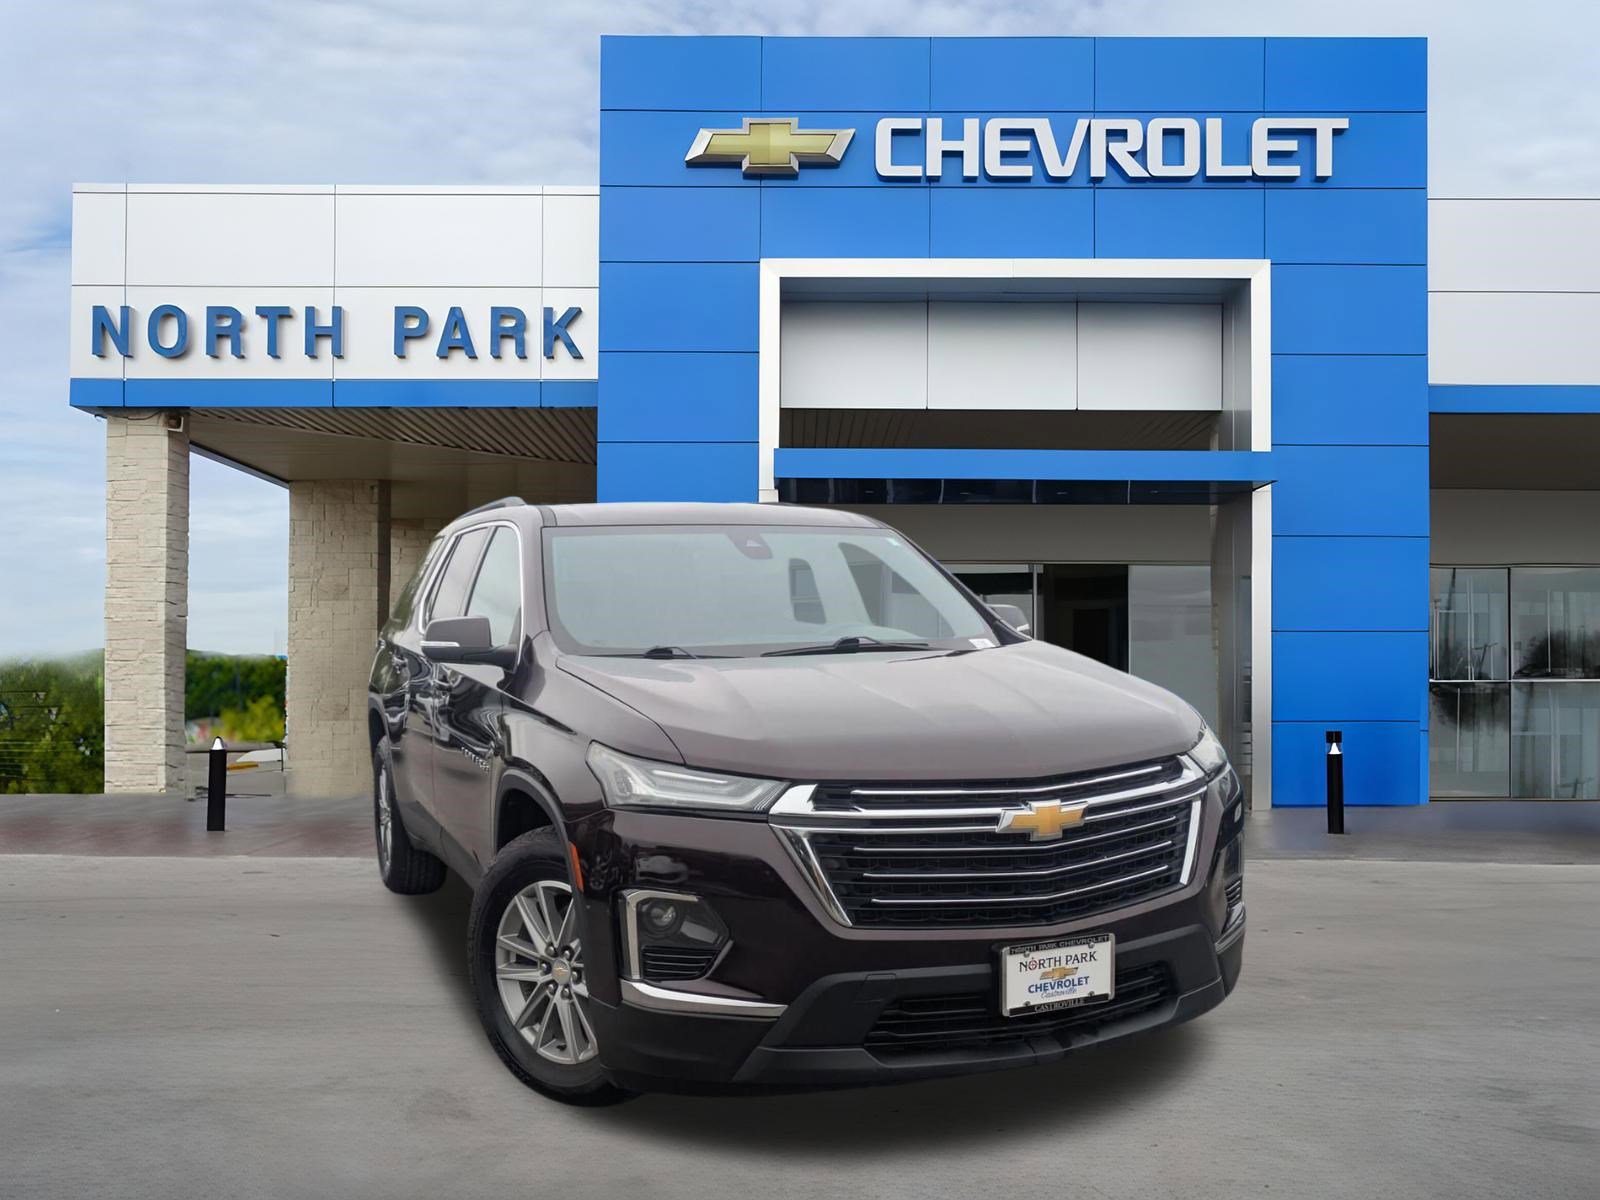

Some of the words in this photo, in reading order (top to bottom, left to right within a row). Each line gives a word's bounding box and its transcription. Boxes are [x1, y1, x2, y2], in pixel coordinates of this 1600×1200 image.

[875, 117, 1349, 180] CHEVROLET
[92, 304, 345, 360] NORTH
[394, 306, 584, 360] PARK
[1059, 936, 1108, 948] CHEVROLET
[1019, 956, 1061, 972] NORTH
[1065, 951, 1097, 964] PARK
[1028, 976, 1089, 994] CHEVROLET
[1034, 998, 1084, 1012] CASTROVILLE
